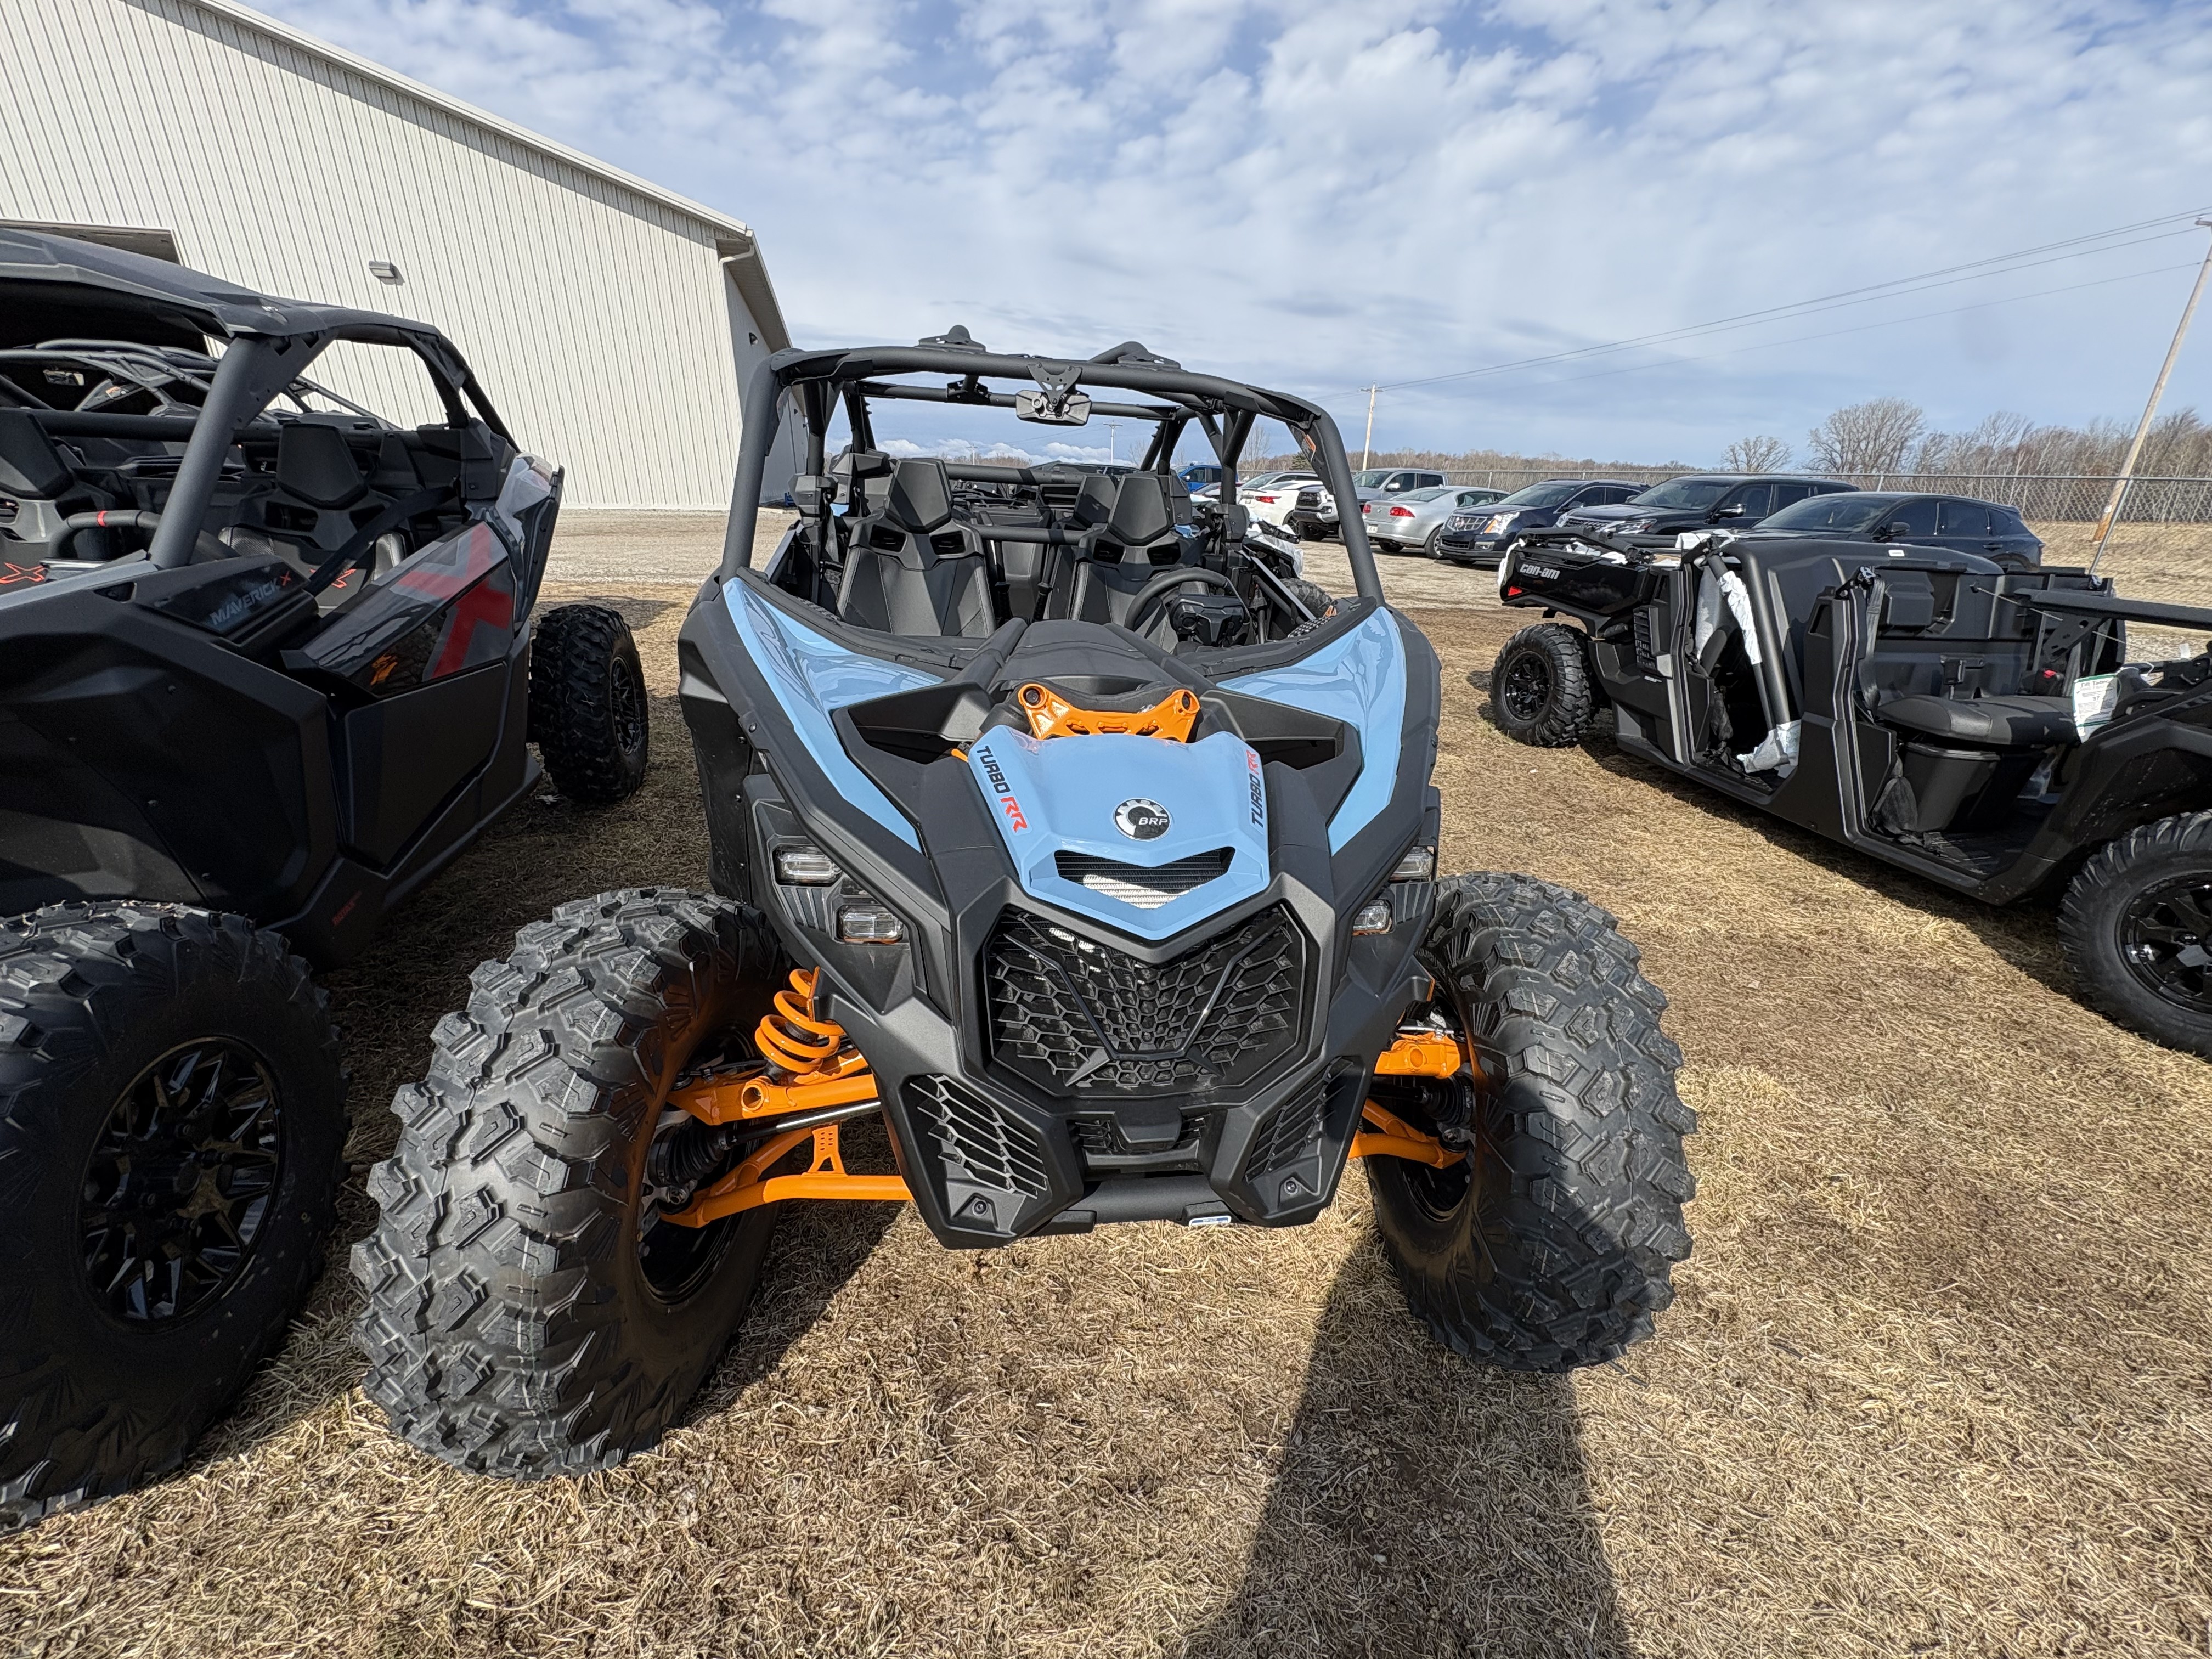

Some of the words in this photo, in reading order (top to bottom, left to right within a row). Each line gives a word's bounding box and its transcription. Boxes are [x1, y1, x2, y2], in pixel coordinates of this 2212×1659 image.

[210, 578, 280, 625] MAVERICK
[279, 571, 292, 586] X
[1520, 563, 1560, 580] can-am
[977, 746, 1011, 794] TURBO
[1000, 797, 1028, 833] RR
[1249, 773, 1263, 828] TURBO
